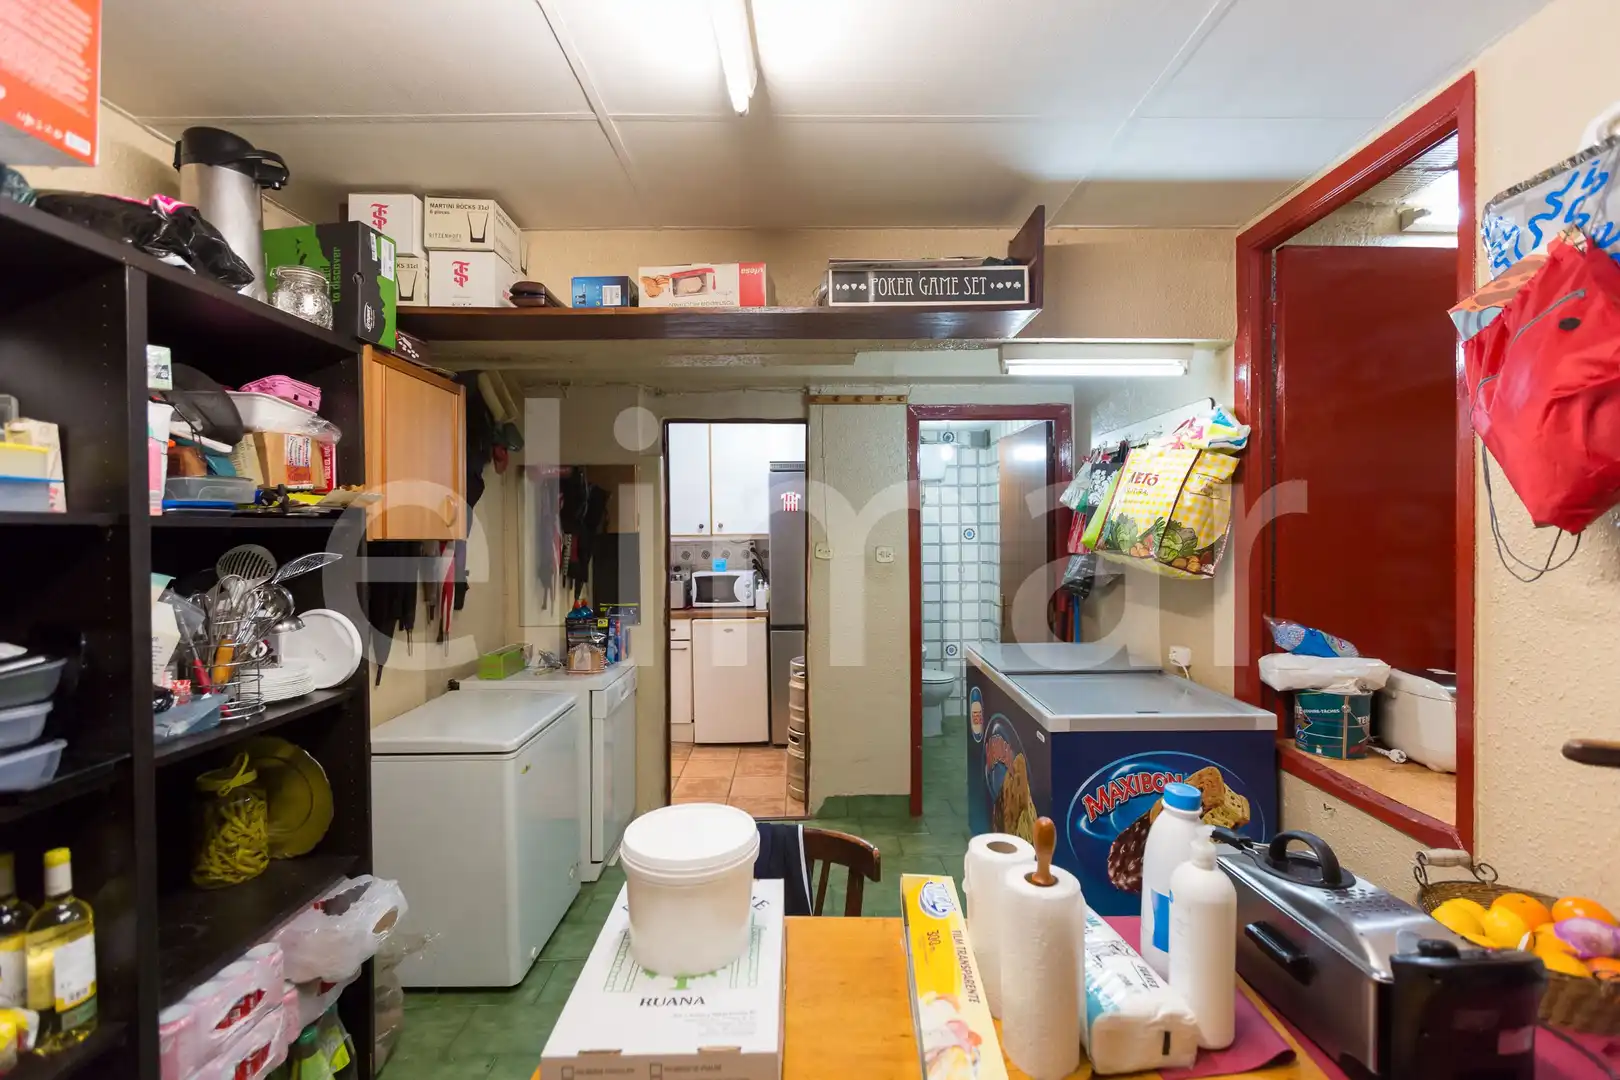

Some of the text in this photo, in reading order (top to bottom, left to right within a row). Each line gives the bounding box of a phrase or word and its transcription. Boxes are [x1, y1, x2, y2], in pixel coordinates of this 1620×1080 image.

[429, 202, 490, 211] MARTINI ROCKS 31cl
[330, 246, 341, 288] discover
[741, 267, 764, 275] ufesa
[871, 276, 987, 296] POKER GAME SET
[1082, 771, 1183, 823] MAXIBON
[951, 929, 981, 1004] FILM TRANSPARENTE
[638, 995, 706, 1008] RUANA
